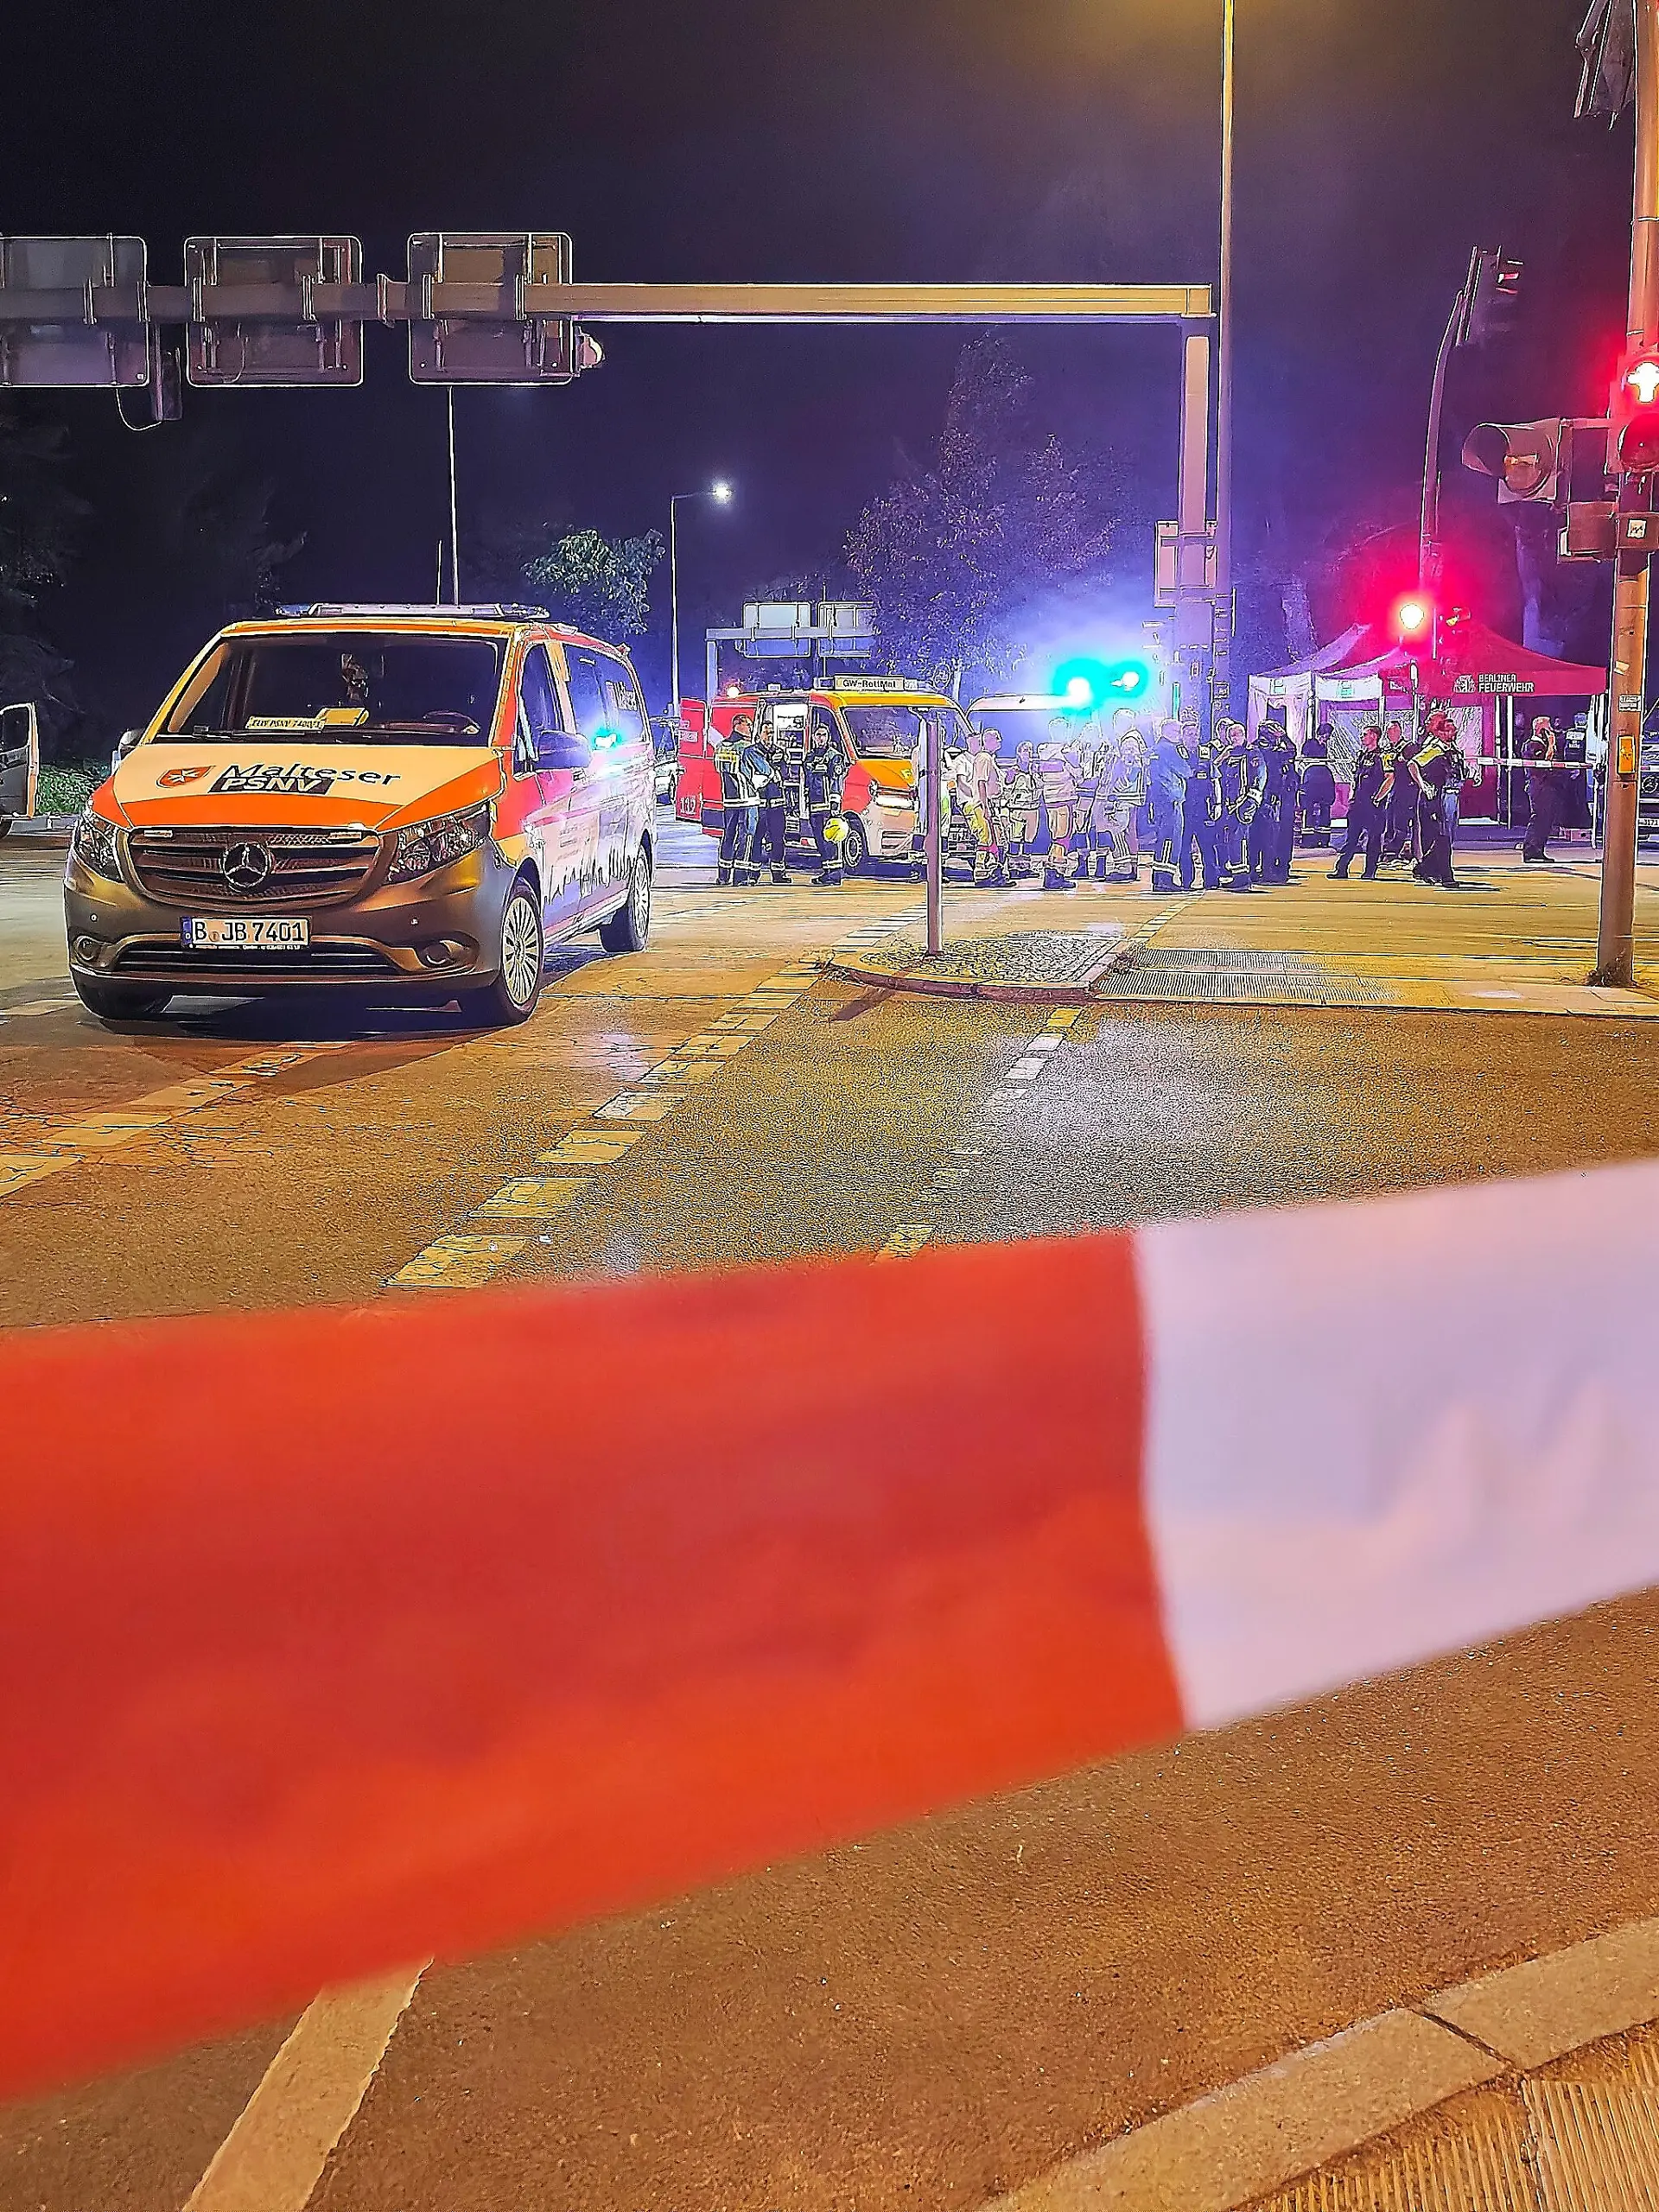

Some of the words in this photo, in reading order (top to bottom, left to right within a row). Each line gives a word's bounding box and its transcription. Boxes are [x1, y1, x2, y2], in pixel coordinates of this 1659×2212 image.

[1478, 683, 1535, 693] FEUERWEHR
[220, 763, 401, 785] Malteser
[220, 778, 321, 792] PSNV
[195, 922, 207, 941] B
[222, 922, 246, 941] JB
[252, 922, 304, 941] 7401
